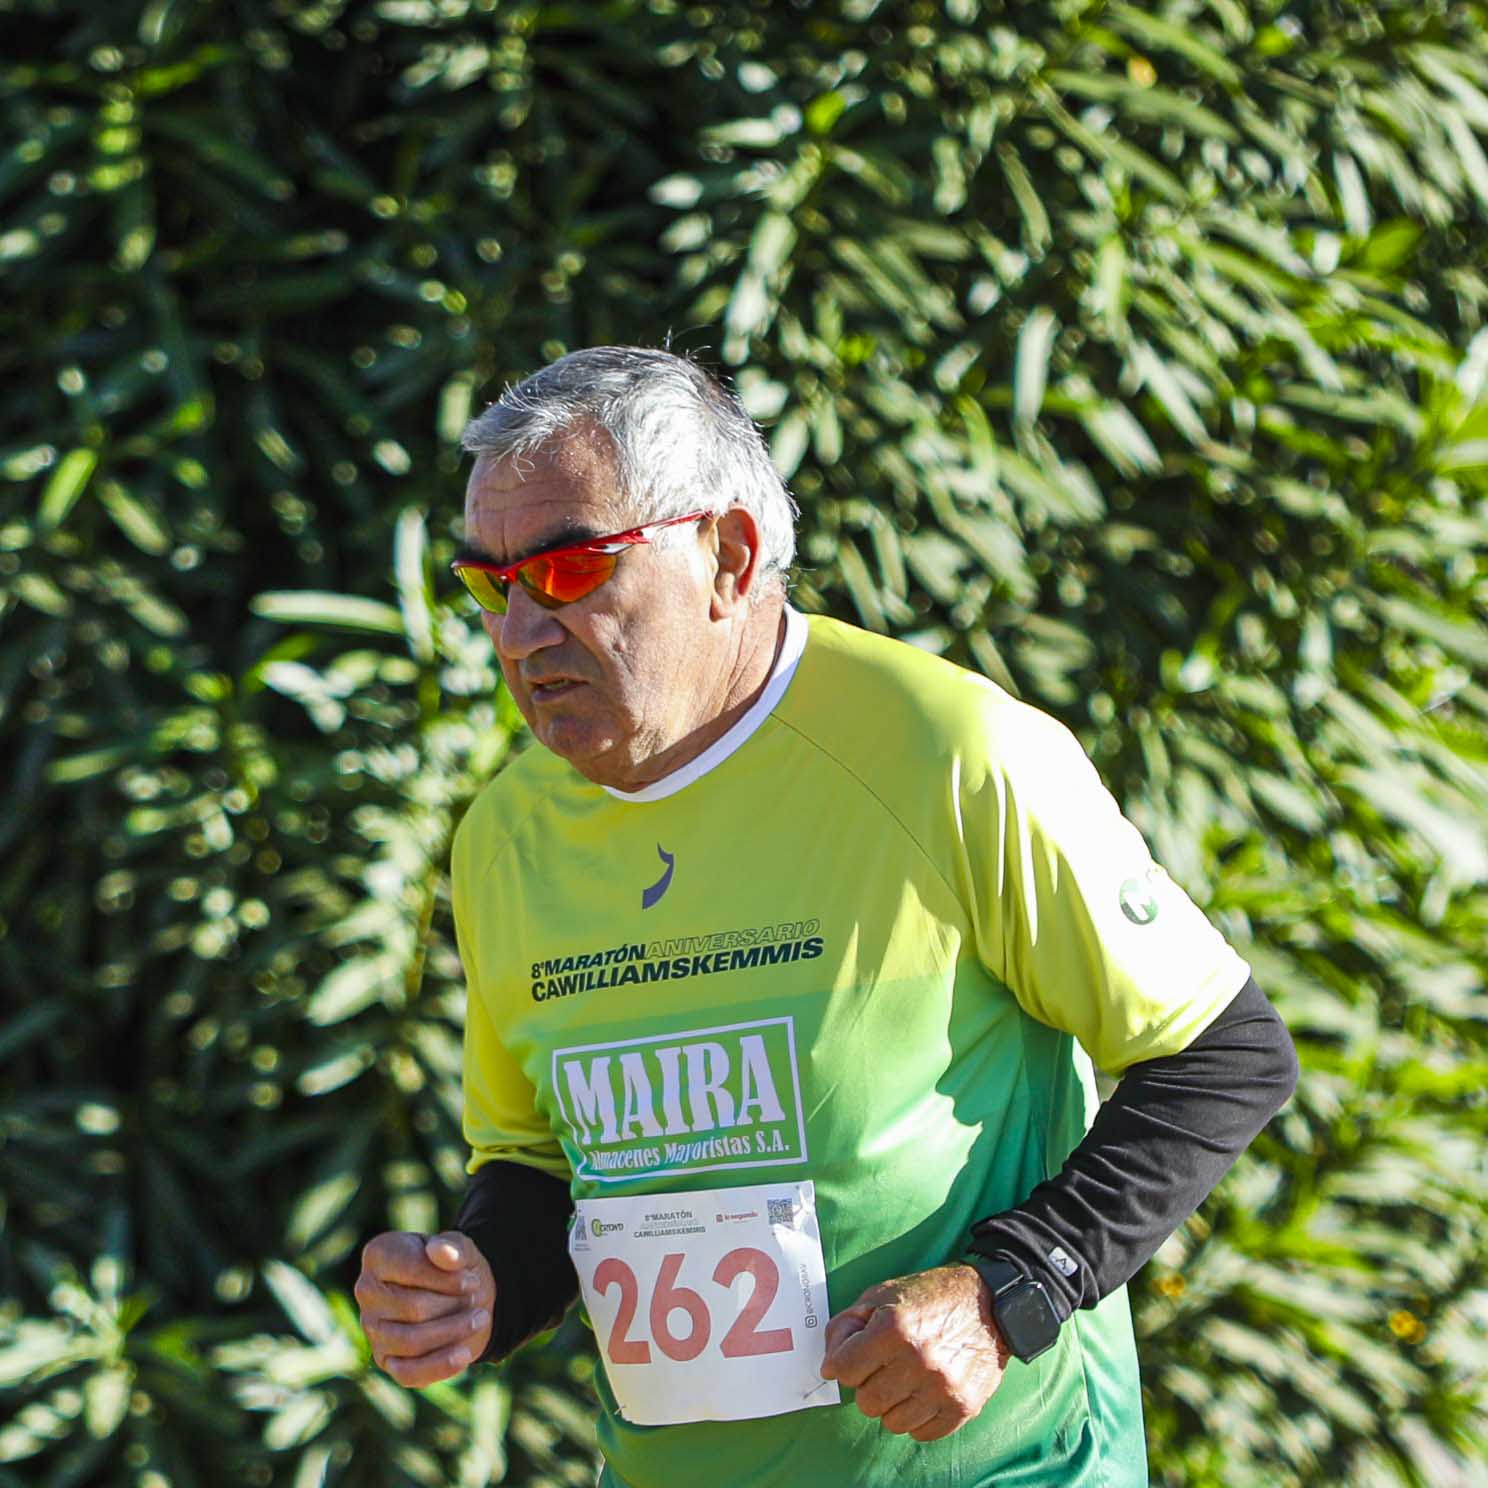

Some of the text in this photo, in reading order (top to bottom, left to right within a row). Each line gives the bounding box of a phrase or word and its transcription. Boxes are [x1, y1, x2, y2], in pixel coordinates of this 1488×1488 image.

[532, 937, 824, 1002] CAWILLIAMSKEMMIS
[646, 919, 820, 959] ANIVERSARIO
[564, 1035, 786, 1145] MAIRA
[664, 1135, 751, 1164] Mayoristas
[755, 1129, 790, 1153] S.A.
[593, 1247, 794, 1365] 262
